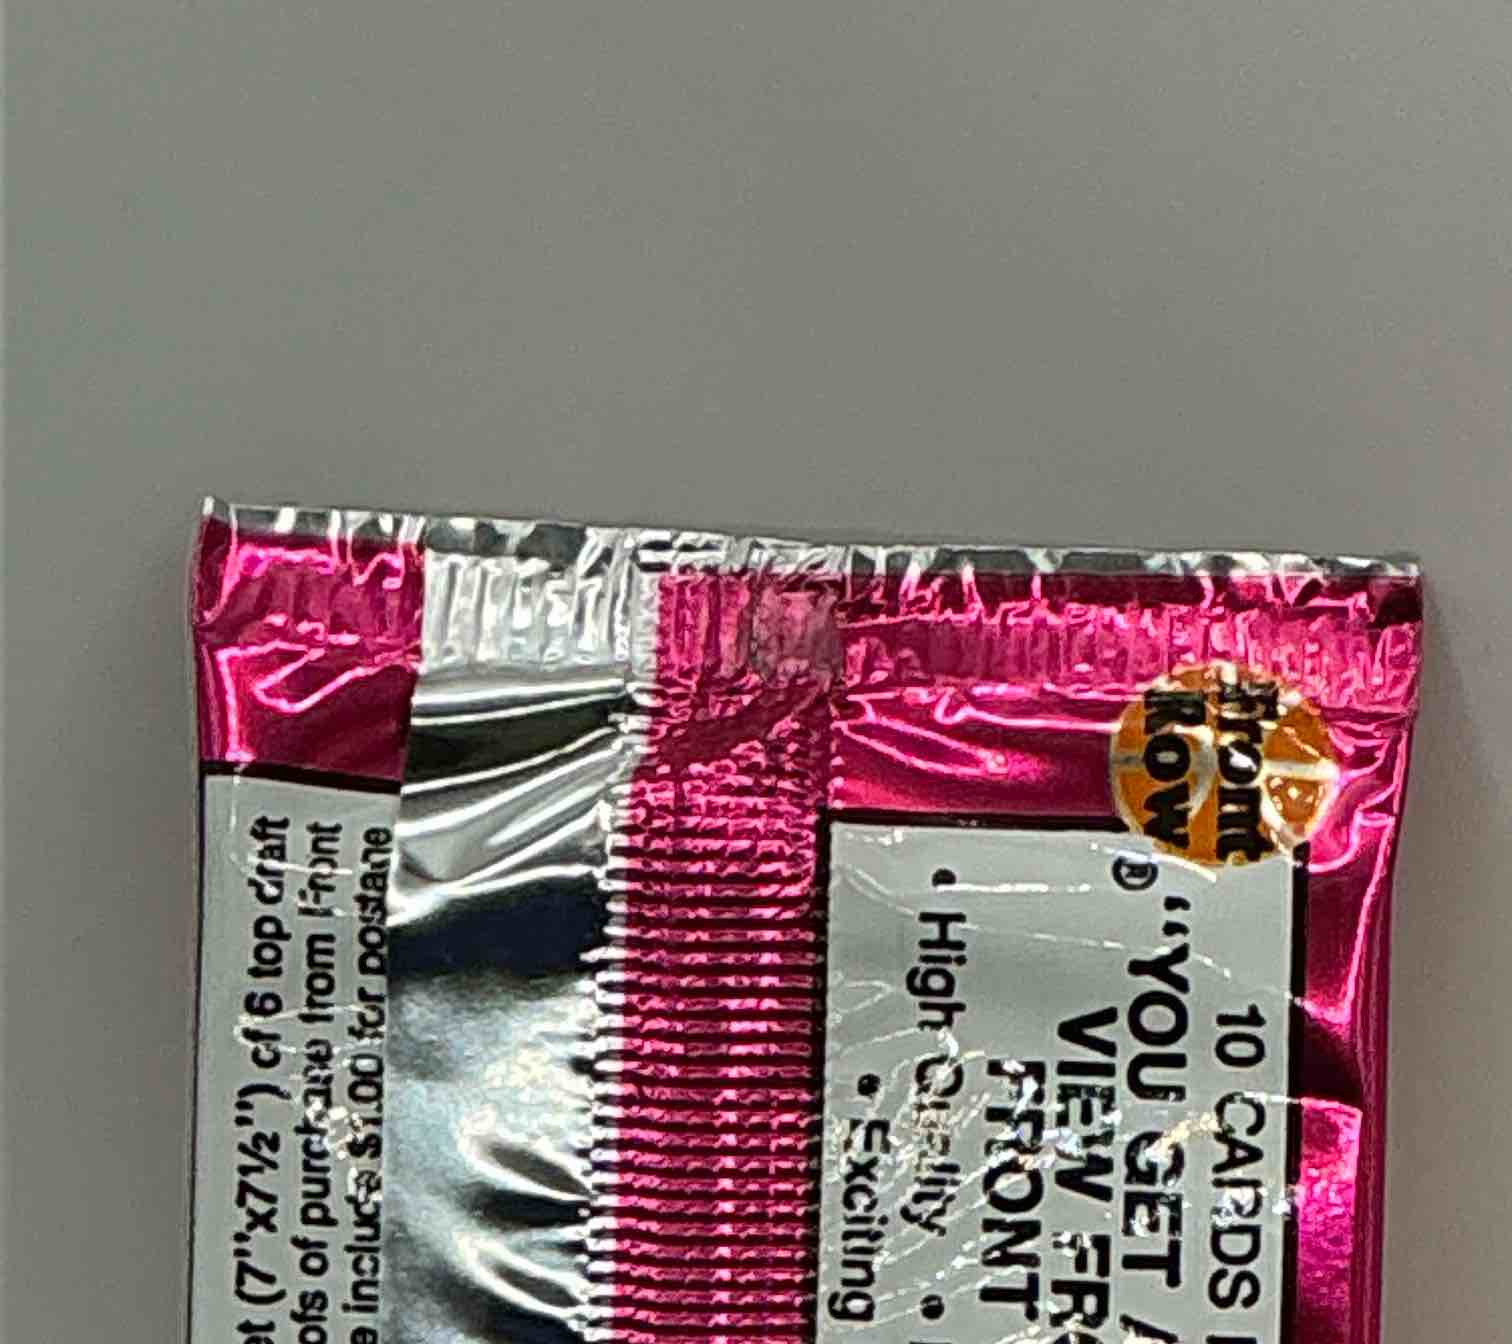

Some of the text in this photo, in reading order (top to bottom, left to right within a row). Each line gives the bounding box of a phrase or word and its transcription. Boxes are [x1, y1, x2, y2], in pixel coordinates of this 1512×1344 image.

[248, 815, 289, 905] draft
[248, 915, 291, 978] top
[298, 934, 336, 1024] from
[905, 912, 967, 1032] High
[241, 1027, 281, 1069] of
[244, 992, 284, 1016] 6
[348, 986, 385, 1042] for
[1214, 1003, 1267, 1068] 10
[295, 1039, 338, 1227] purchase
[1055, 1007, 1118, 1204] VIEW
[342, 1169, 382, 1313] include
[828, 1119, 890, 1322] Exciting
[978, 1059, 1046, 1321] FRONT
[1121, 1131, 1185, 1289] GET
[1207, 1092, 1267, 1311] CARDS
[290, 1236, 329, 1277] of
